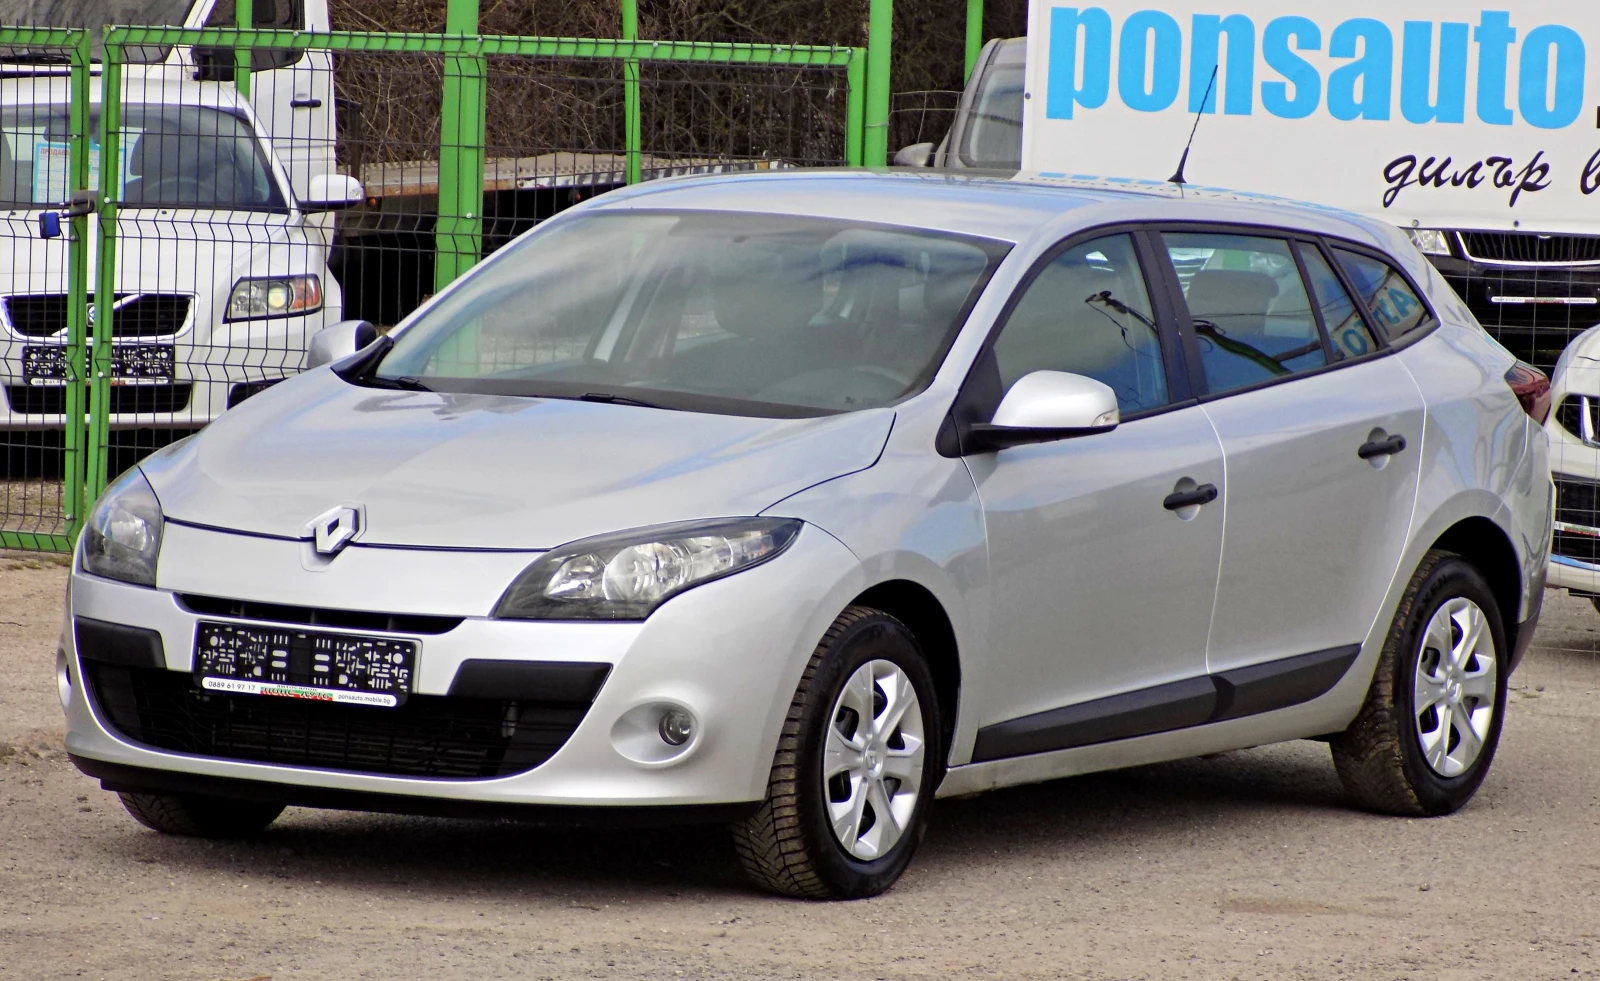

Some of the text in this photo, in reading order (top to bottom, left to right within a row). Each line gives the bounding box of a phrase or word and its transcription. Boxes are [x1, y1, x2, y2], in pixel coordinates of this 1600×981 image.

[1046, 6, 1600, 129] ponsauto
[1383, 150, 1552, 208] дилър
[338, 694, 391, 705] ponsauto.mobile.bg
